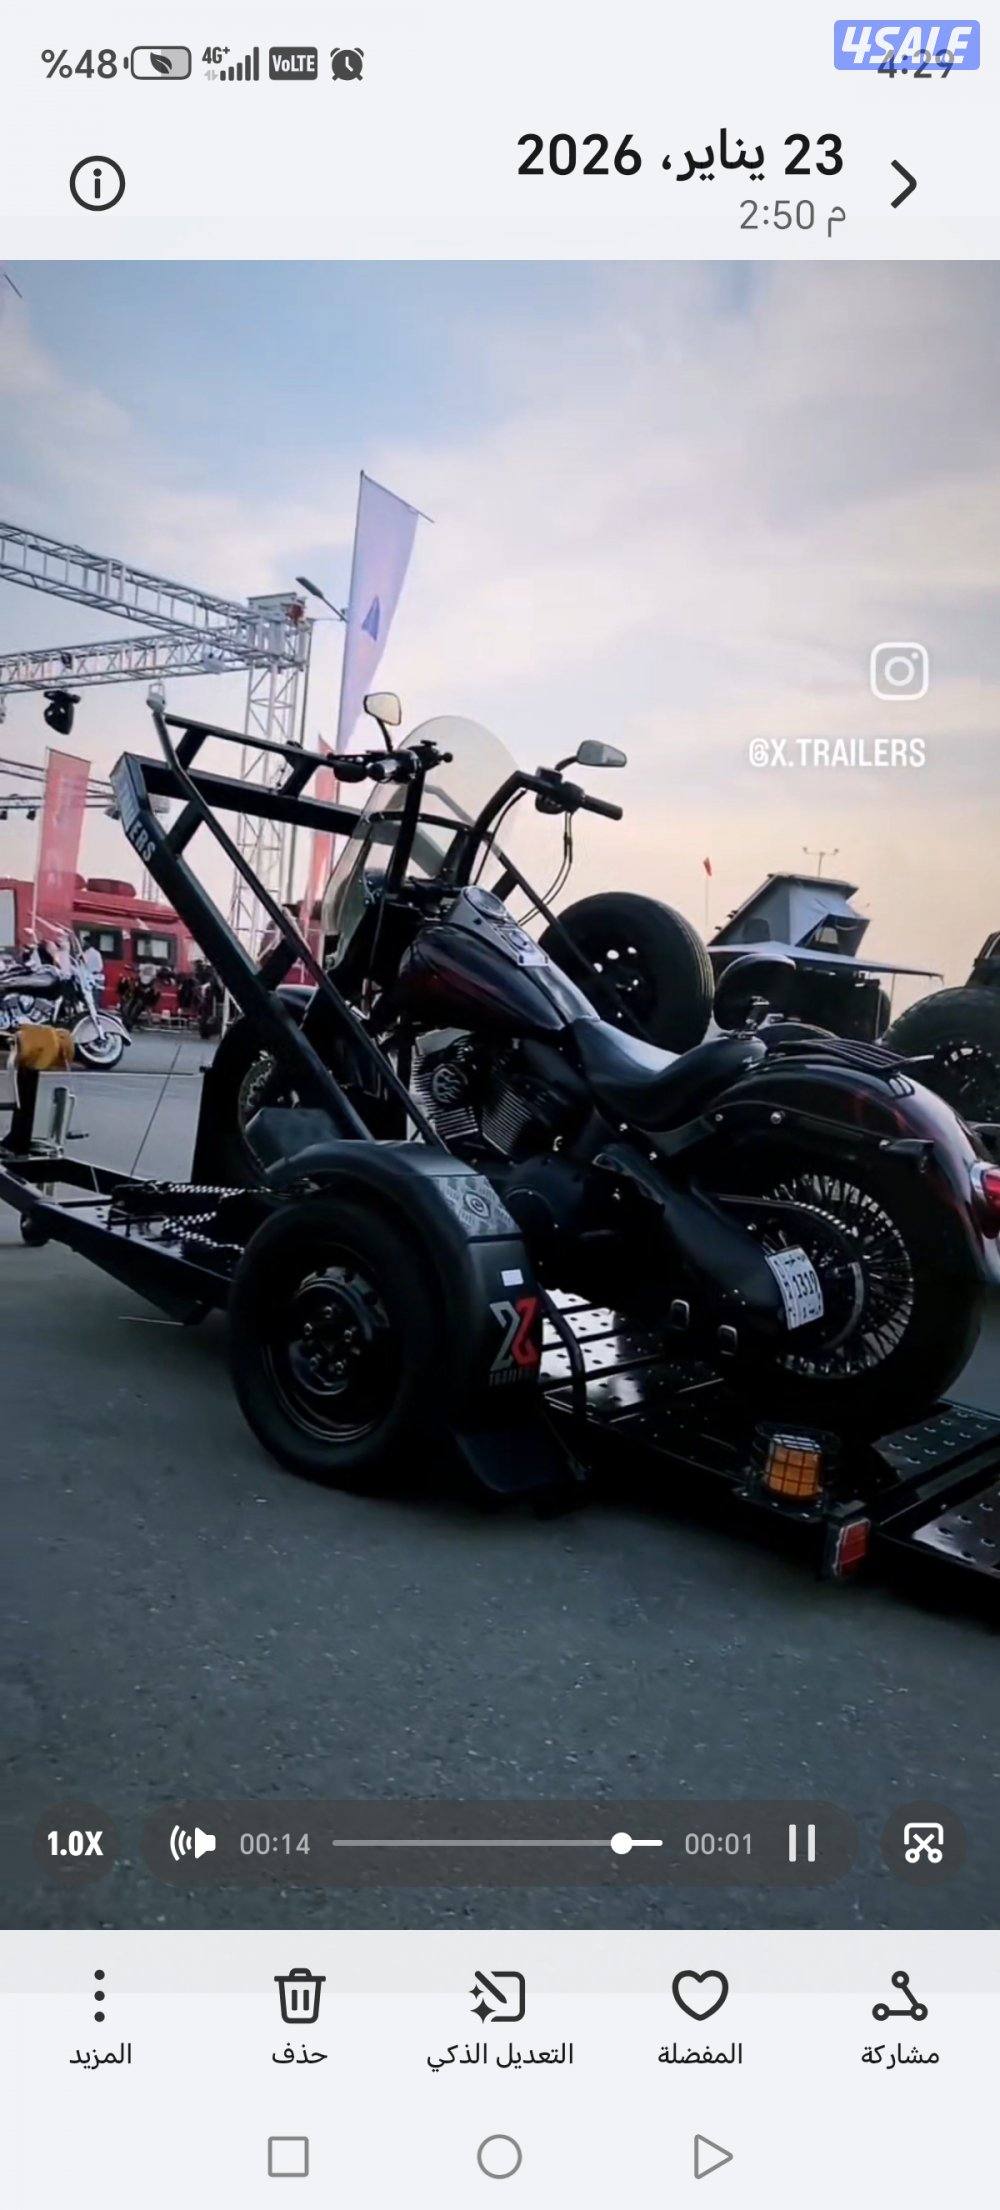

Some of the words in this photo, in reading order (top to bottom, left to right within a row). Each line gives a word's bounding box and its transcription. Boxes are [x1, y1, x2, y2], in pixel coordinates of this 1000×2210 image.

[272, 54, 316, 72] VoLTE
[878, 49, 954, 78] 4:29
[517, 133, 642, 175] 2026
[662, 128, 765, 181] يناير،
[784, 133, 843, 175] 23
[740, 200, 814, 229] 2:50
[828, 206, 846, 237] م
[48, 1831, 103, 1856] 1.0X
[240, 1833, 310, 1855] 00:14
[685, 1833, 752, 1855] 00:01
[69, 2043, 132, 2070] المزيد
[271, 2042, 328, 2065] حذف
[426, 2042, 488, 2072] الذكي
[496, 2042, 574, 2070] التعديل
[658, 2042, 743, 2065] المفضلة
[861, 2043, 940, 2070] مشاركة
